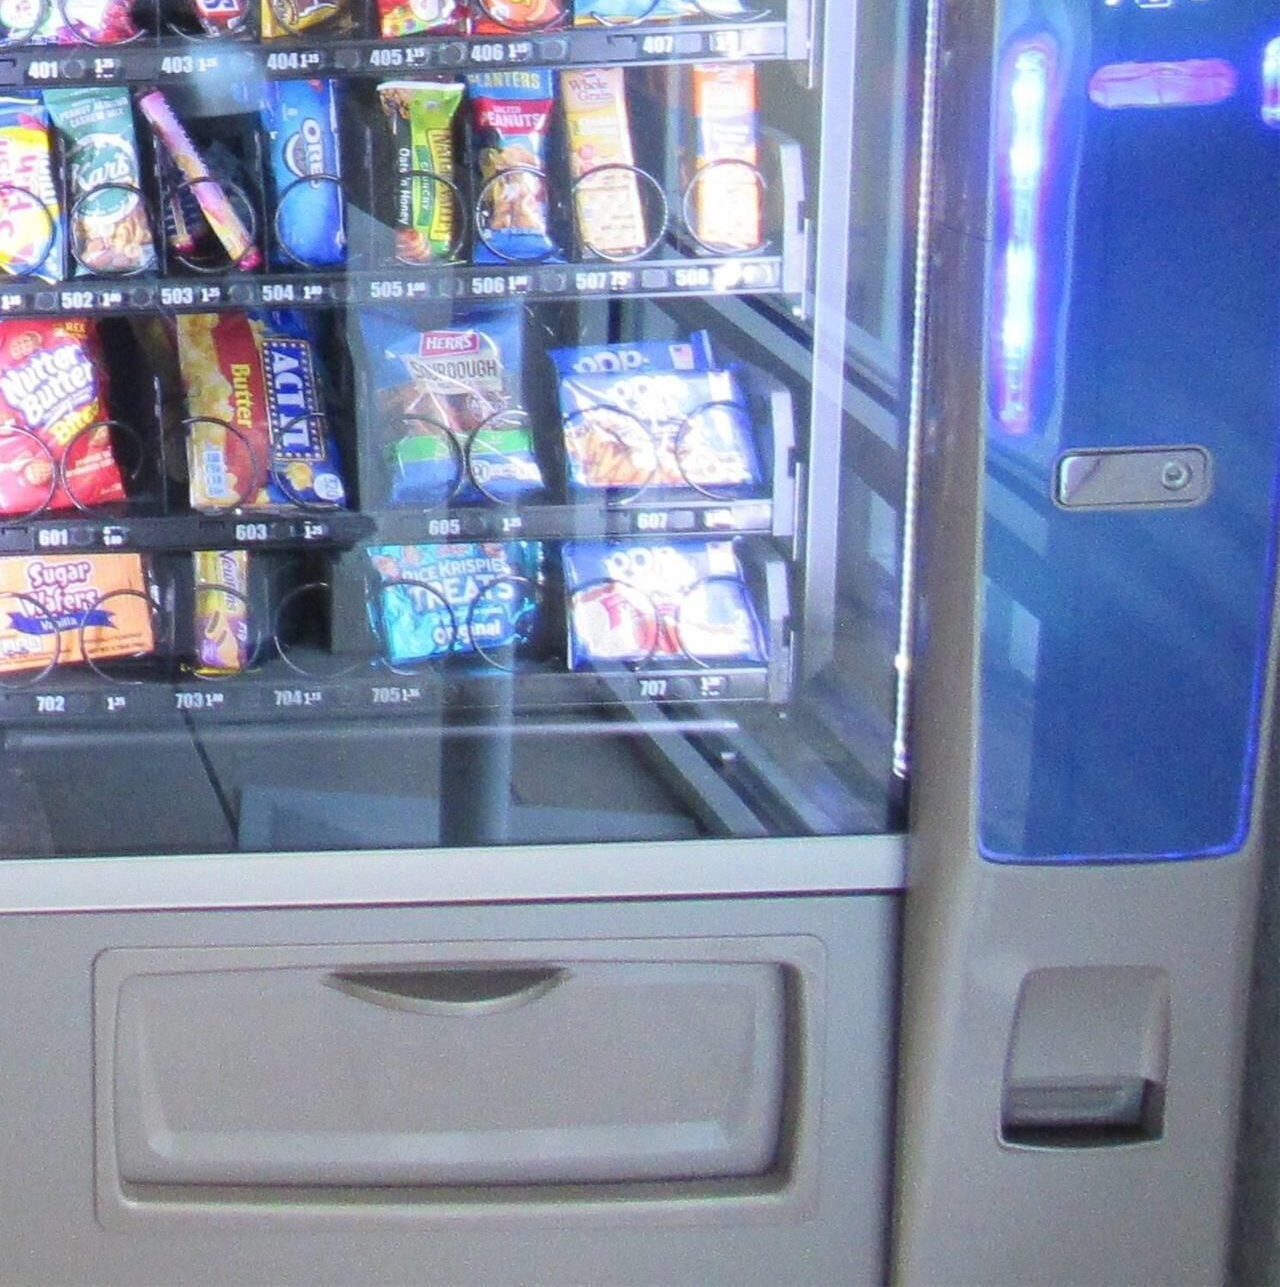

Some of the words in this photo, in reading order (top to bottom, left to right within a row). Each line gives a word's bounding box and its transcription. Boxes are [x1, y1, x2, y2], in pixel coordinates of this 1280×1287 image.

[471, 44, 504, 61] 406
[642, 35, 674, 54] 407
[161, 56, 192, 74] 403
[267, 52, 299, 70] 404
[370, 48, 402, 66] 405
[28, 61, 58, 79] 401
[370, 280, 402, 298] 505
[472, 277, 505, 294] 506
[575, 271, 607, 290] 507
[62, 291, 94, 309] 502
[161, 287, 193, 305] 503
[262, 284, 295, 301] 504
[0, 344, 83, 403] Nutter
[21, 361, 95, 426] Butter
[230, 363, 253, 429] Butter
[428, 519, 461, 536] 605
[637, 512, 668, 529] 607
[38, 529, 69, 546] 601
[235, 523, 268, 541] 603
[27, 561, 91, 589] Sugar
[439, 557, 512, 576] KRISPIES
[17, 588, 100, 618] Wafers
[408, 574, 515, 614] TREATS
[371, 687, 401, 703] 705
[639, 679, 668, 697] 707
[35, 695, 66, 712] 702
[175, 692, 204, 709] 703
[273, 689, 303, 706] 704
